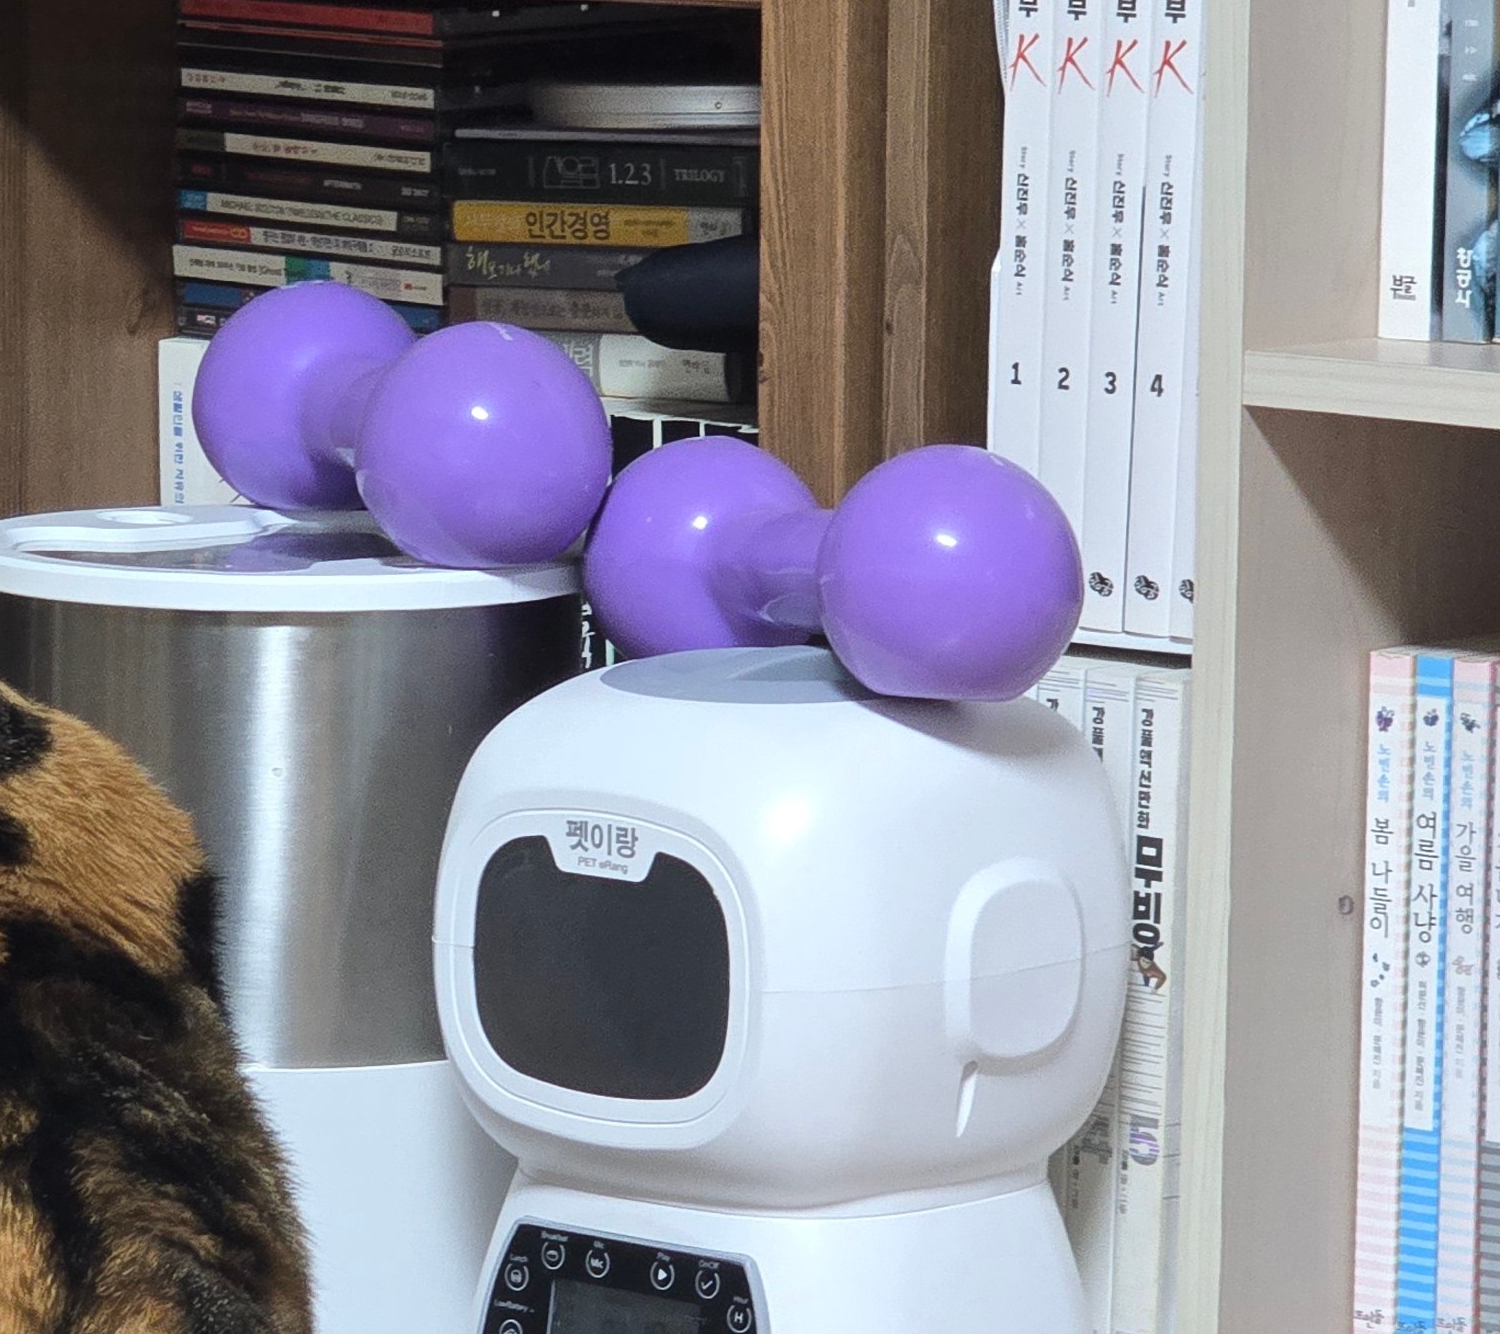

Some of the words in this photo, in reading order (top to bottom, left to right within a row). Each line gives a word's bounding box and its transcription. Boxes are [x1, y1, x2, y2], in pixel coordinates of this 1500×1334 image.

[1010, 33, 1046, 90] K
[1058, 36, 1095, 95] K
[1106, 39, 1145, 95] K
[1154, 39, 1194, 96] K
[610, 162, 652, 186] 1.2.3
[674, 168, 726, 183] TRILOGY
[1019, 146, 1028, 168] Story
[1068, 150, 1076, 173] Story
[1116, 153, 1124, 175] Story
[1164, 155, 1172, 177] Story
[1016, 173, 1029, 215] 신진우
[1064, 177, 1077, 219] 신진우
[1112, 180, 1125, 223] 신진우
[1160, 182, 1173, 224] 신진우
[526, 209, 611, 241] 인간경영
[1063, 286, 1071, 301] Art
[1011, 361, 1022, 385] 1
[1057, 367, 1071, 391] 2
[1104, 371, 1118, 395] 3
[1150, 374, 1164, 397] 4
[1377, 743, 1390, 802] 노빈손의
[1423, 741, 1436, 801] 노빈손의
[1460, 749, 1473, 811] 노빈손의
[566, 820, 638, 858] 펫이랑
[1372, 818, 1394, 845] 봄
[1414, 810, 1439, 871] 여름
[1455, 821, 1477, 873] 가을
[578, 856, 597, 867] PET
[1133, 835, 1164, 945] 무빙
[1371, 861, 1394, 939] 나들이
[1455, 883, 1476, 935] 여행
[1412, 883, 1438, 944] 사냥
[734, 1312, 743, 1323] H
